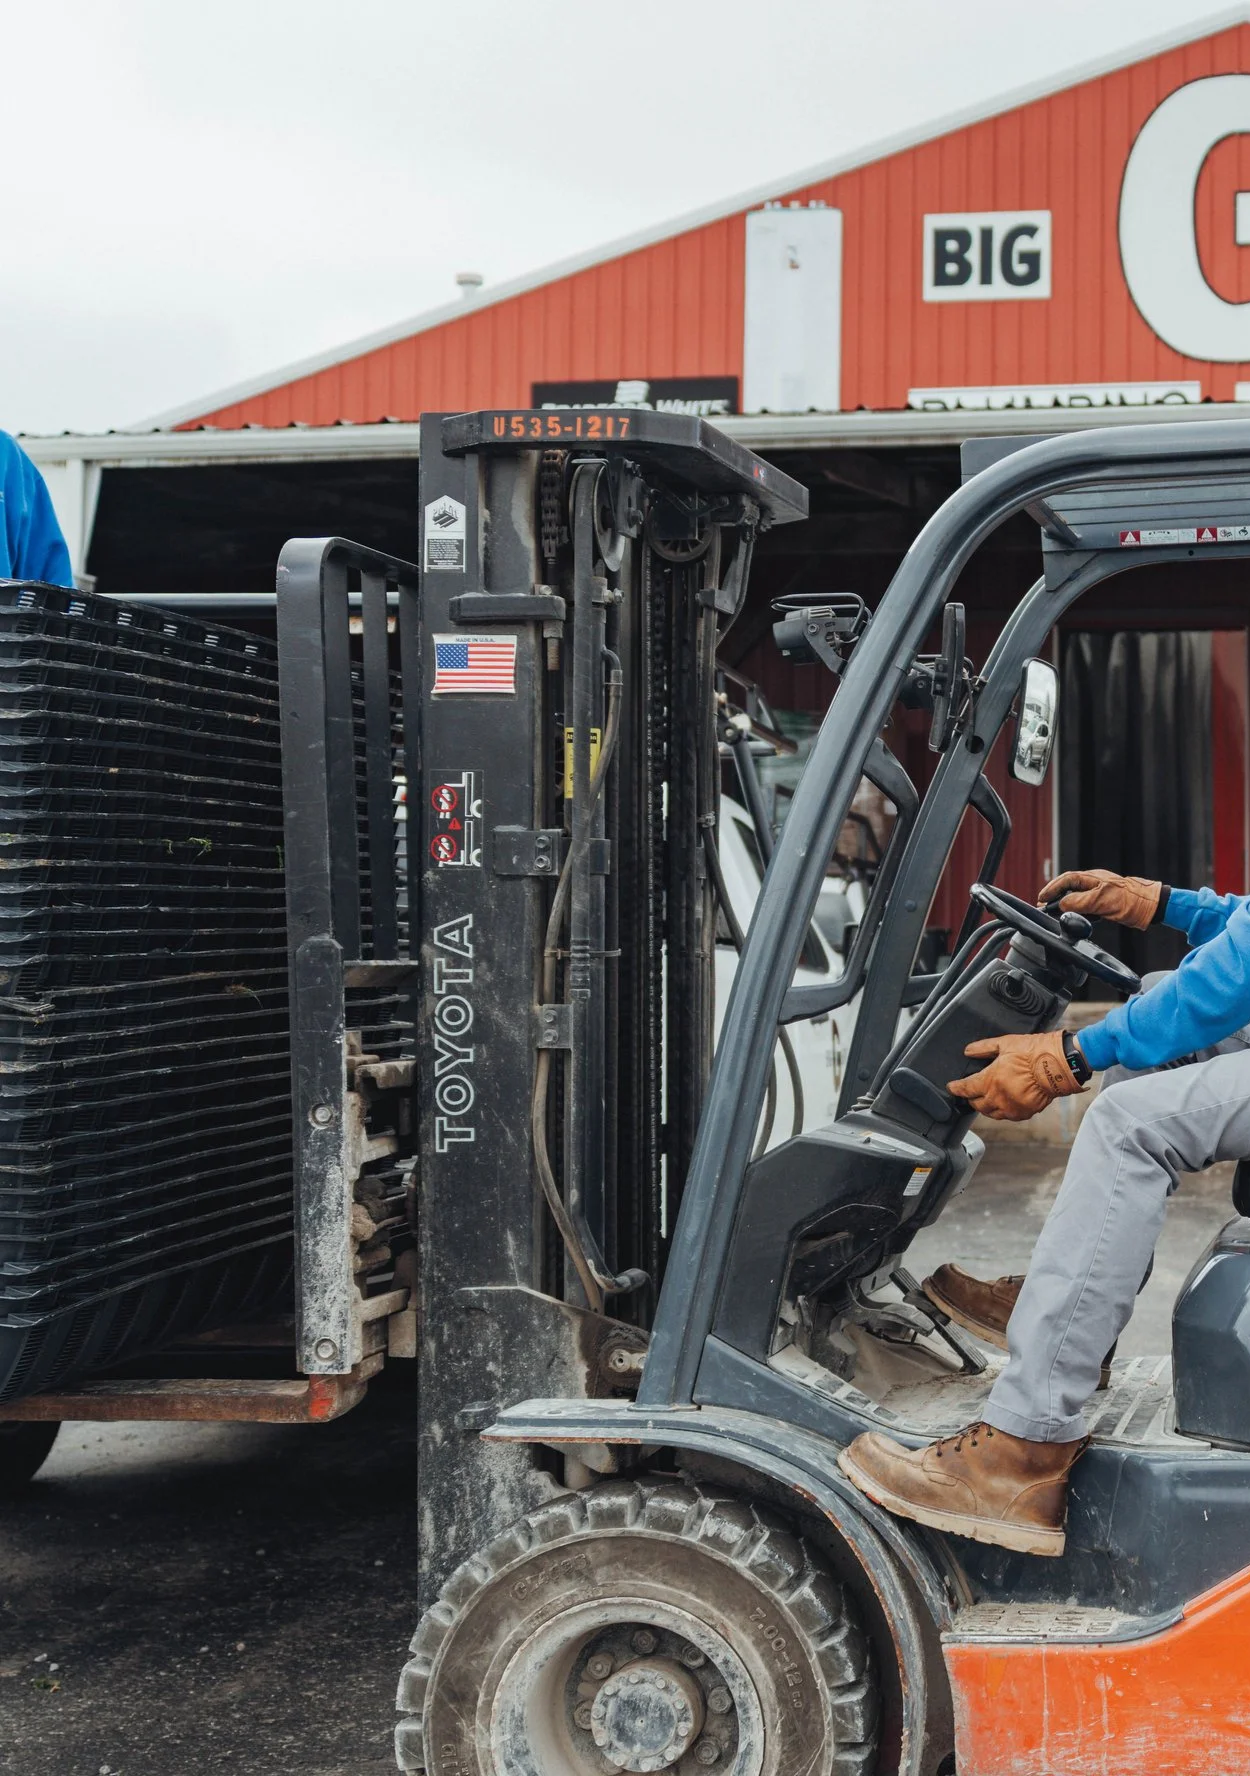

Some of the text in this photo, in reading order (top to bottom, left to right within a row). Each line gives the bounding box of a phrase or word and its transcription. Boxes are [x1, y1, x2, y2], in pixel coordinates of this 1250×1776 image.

[931, 224, 1042, 288] BIG
[493, 416, 630, 438] U535-1217
[433, 913, 475, 1153] TOYOTA
[749, 1607, 803, 1687] 7.00-12
